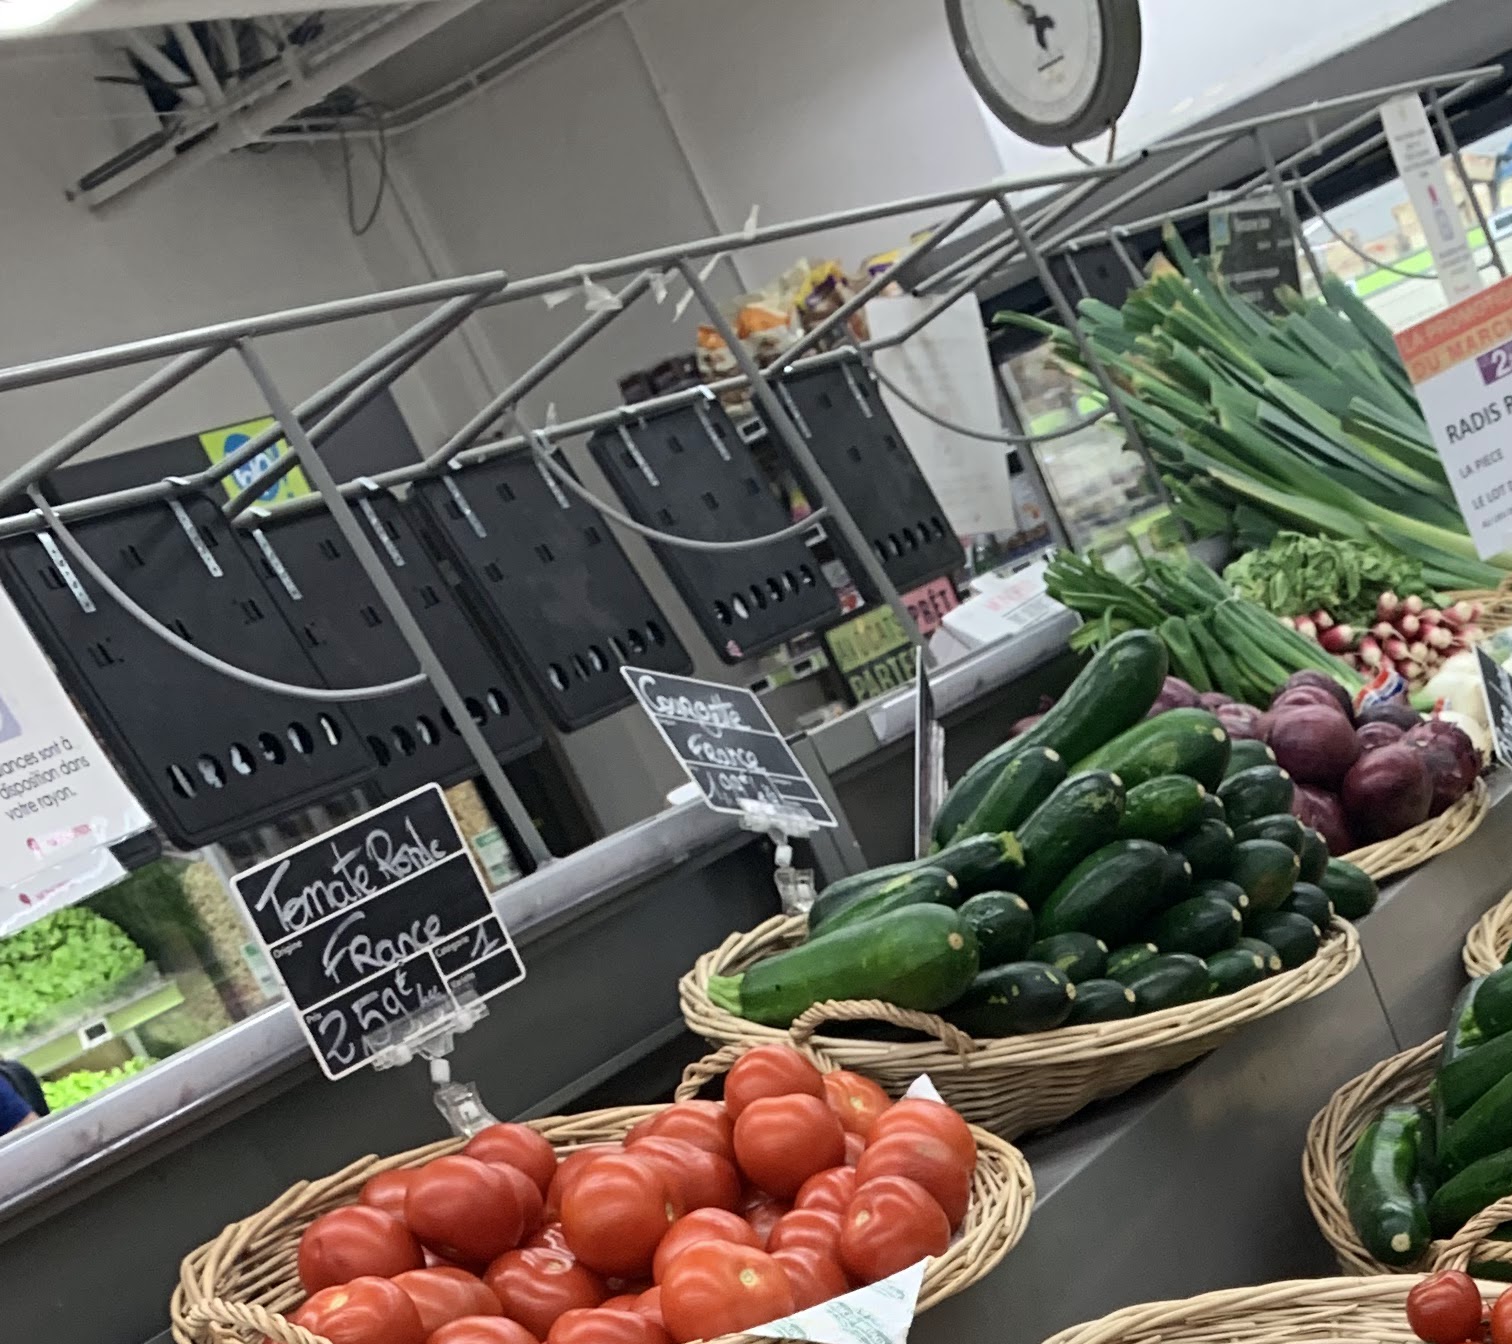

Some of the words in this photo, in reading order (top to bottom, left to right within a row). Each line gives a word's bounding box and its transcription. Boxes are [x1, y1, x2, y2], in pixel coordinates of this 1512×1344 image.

[1411, 354, 1441, 379] DU
[1445, 402, 1502, 444] RADIS
[1459, 463, 1474, 479] LA
[1471, 495, 1485, 510] LE
[1487, 484, 1507, 505] LOT
[40, 742, 62, 763] sont
[62, 736, 73, 752] à
[59, 756, 91, 777] dans
[5, 794, 37, 822] votre
[255, 841, 377, 931] Tomate
[365, 816, 447, 881] Ronde
